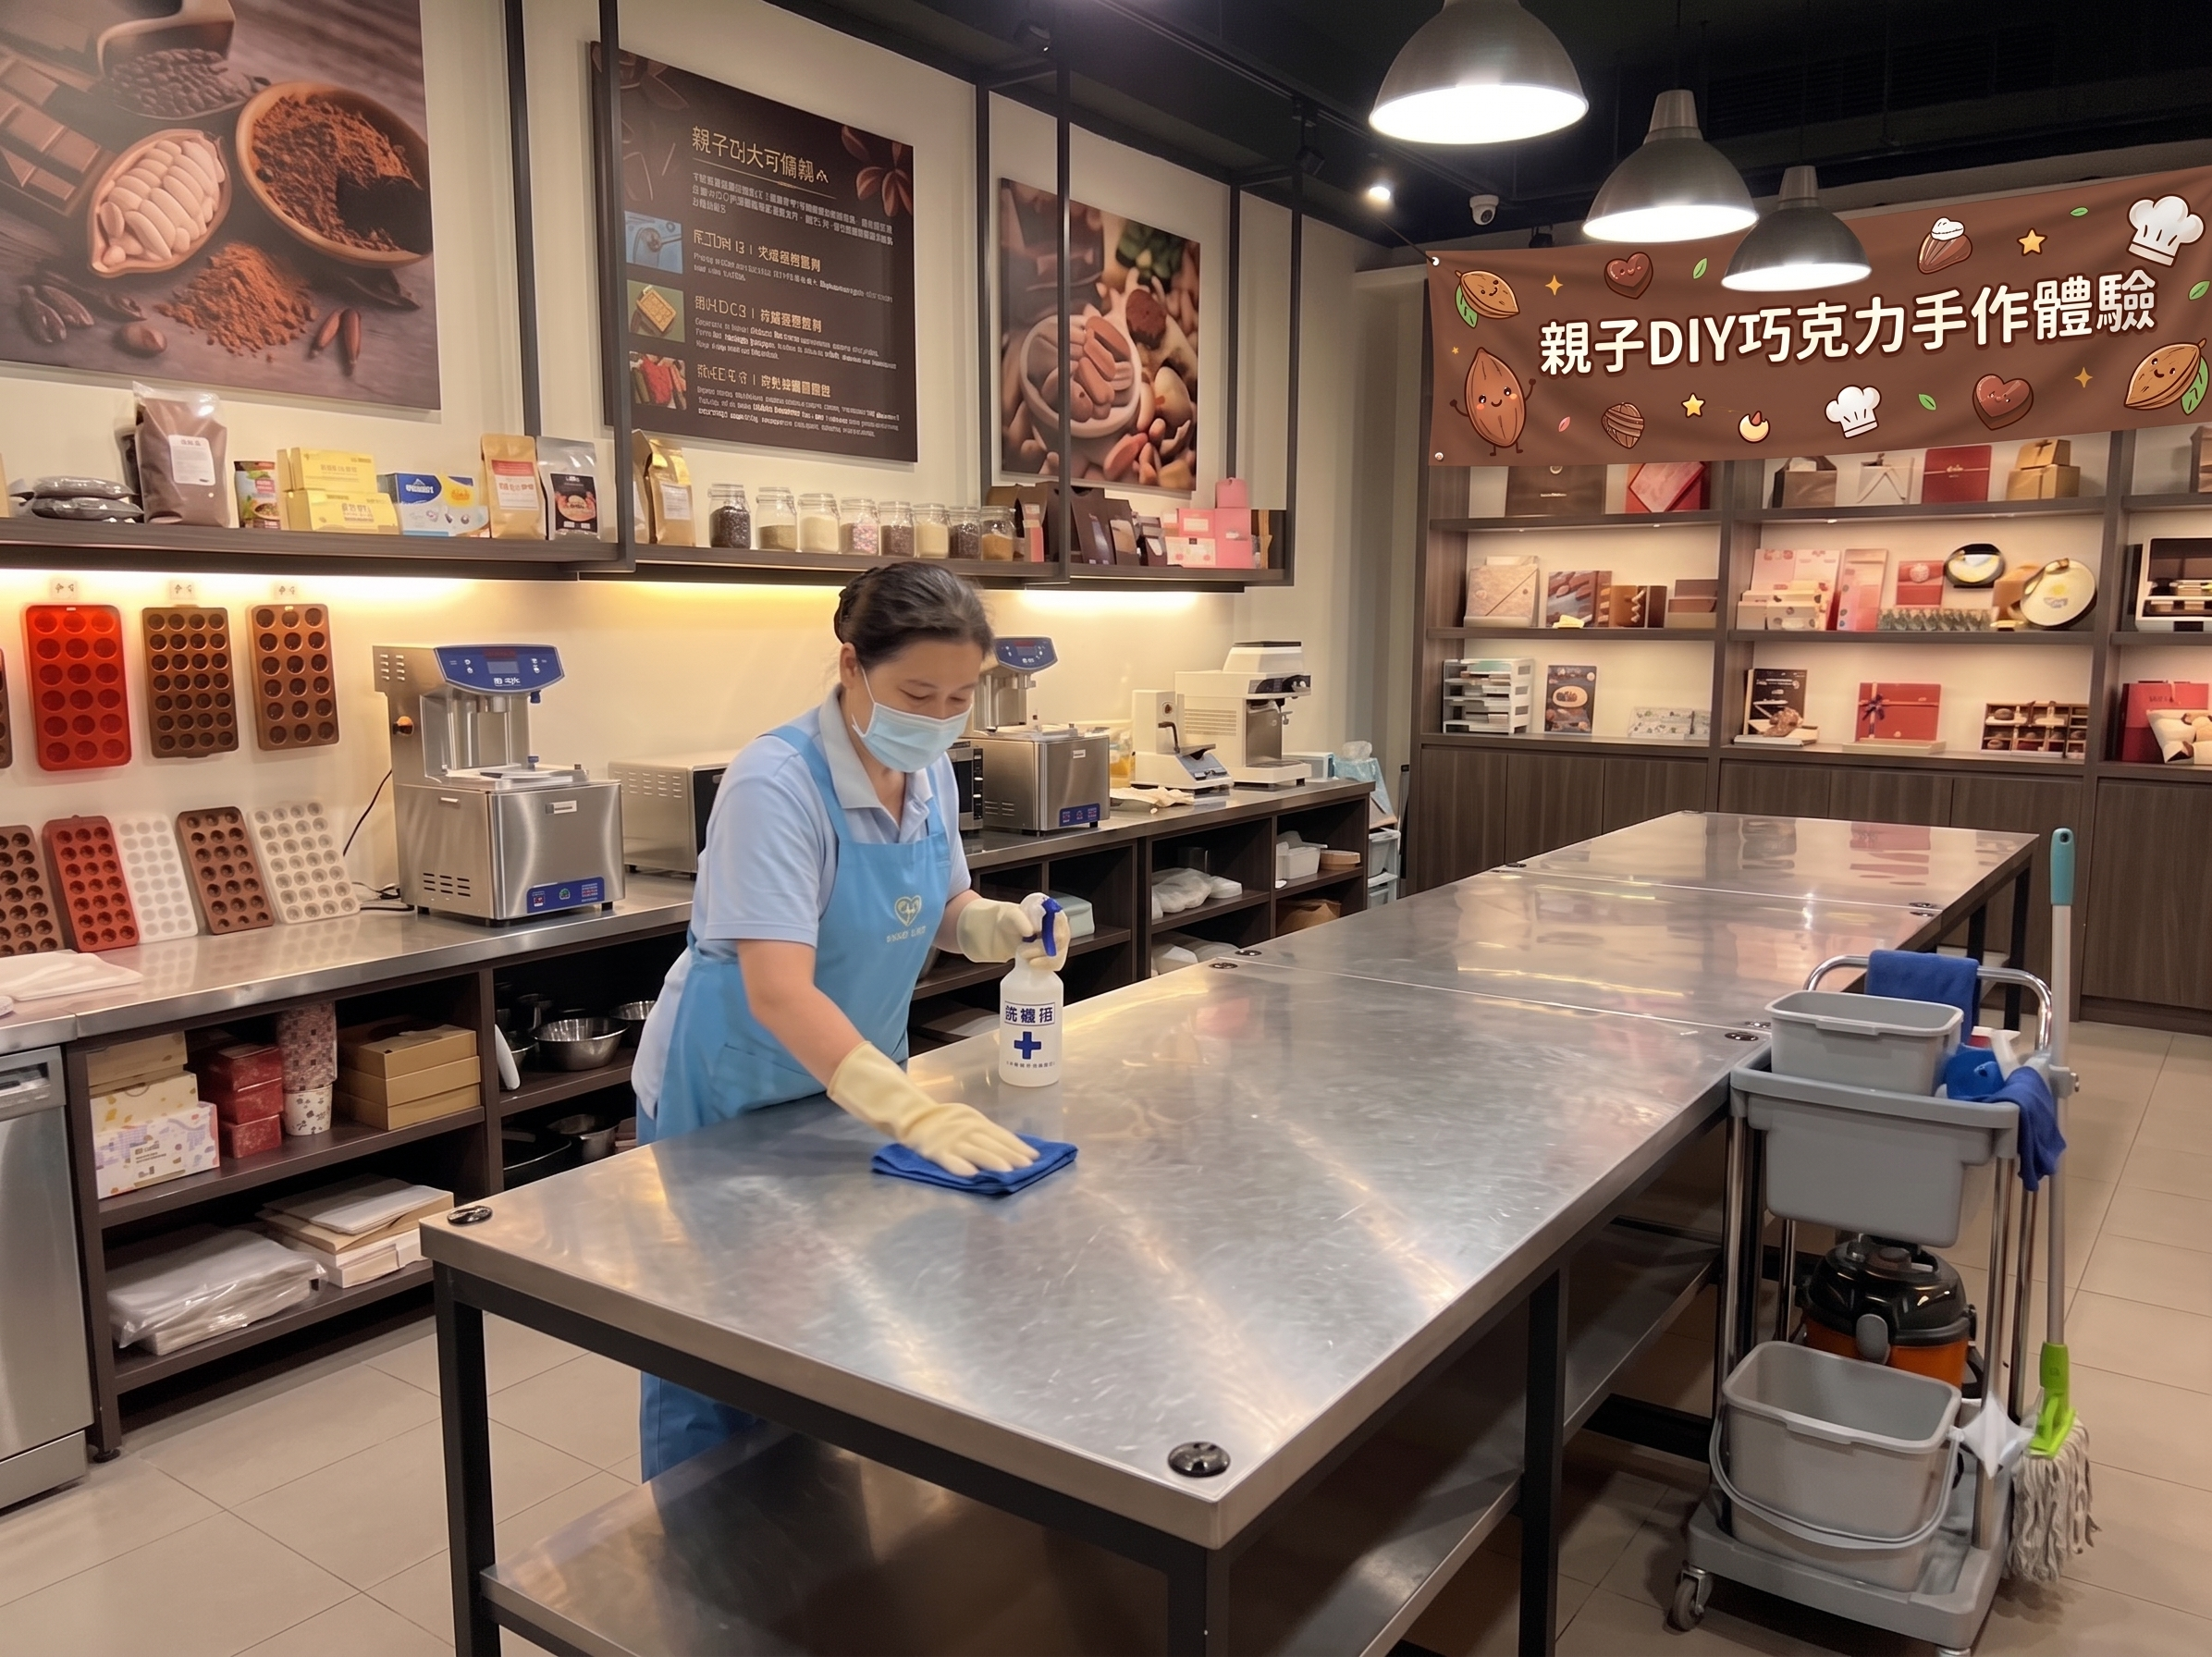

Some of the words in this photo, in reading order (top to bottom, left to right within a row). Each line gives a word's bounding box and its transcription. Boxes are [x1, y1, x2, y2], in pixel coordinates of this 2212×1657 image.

[1540, 268, 2157, 375] 親子DIY巧克力手作體驗
